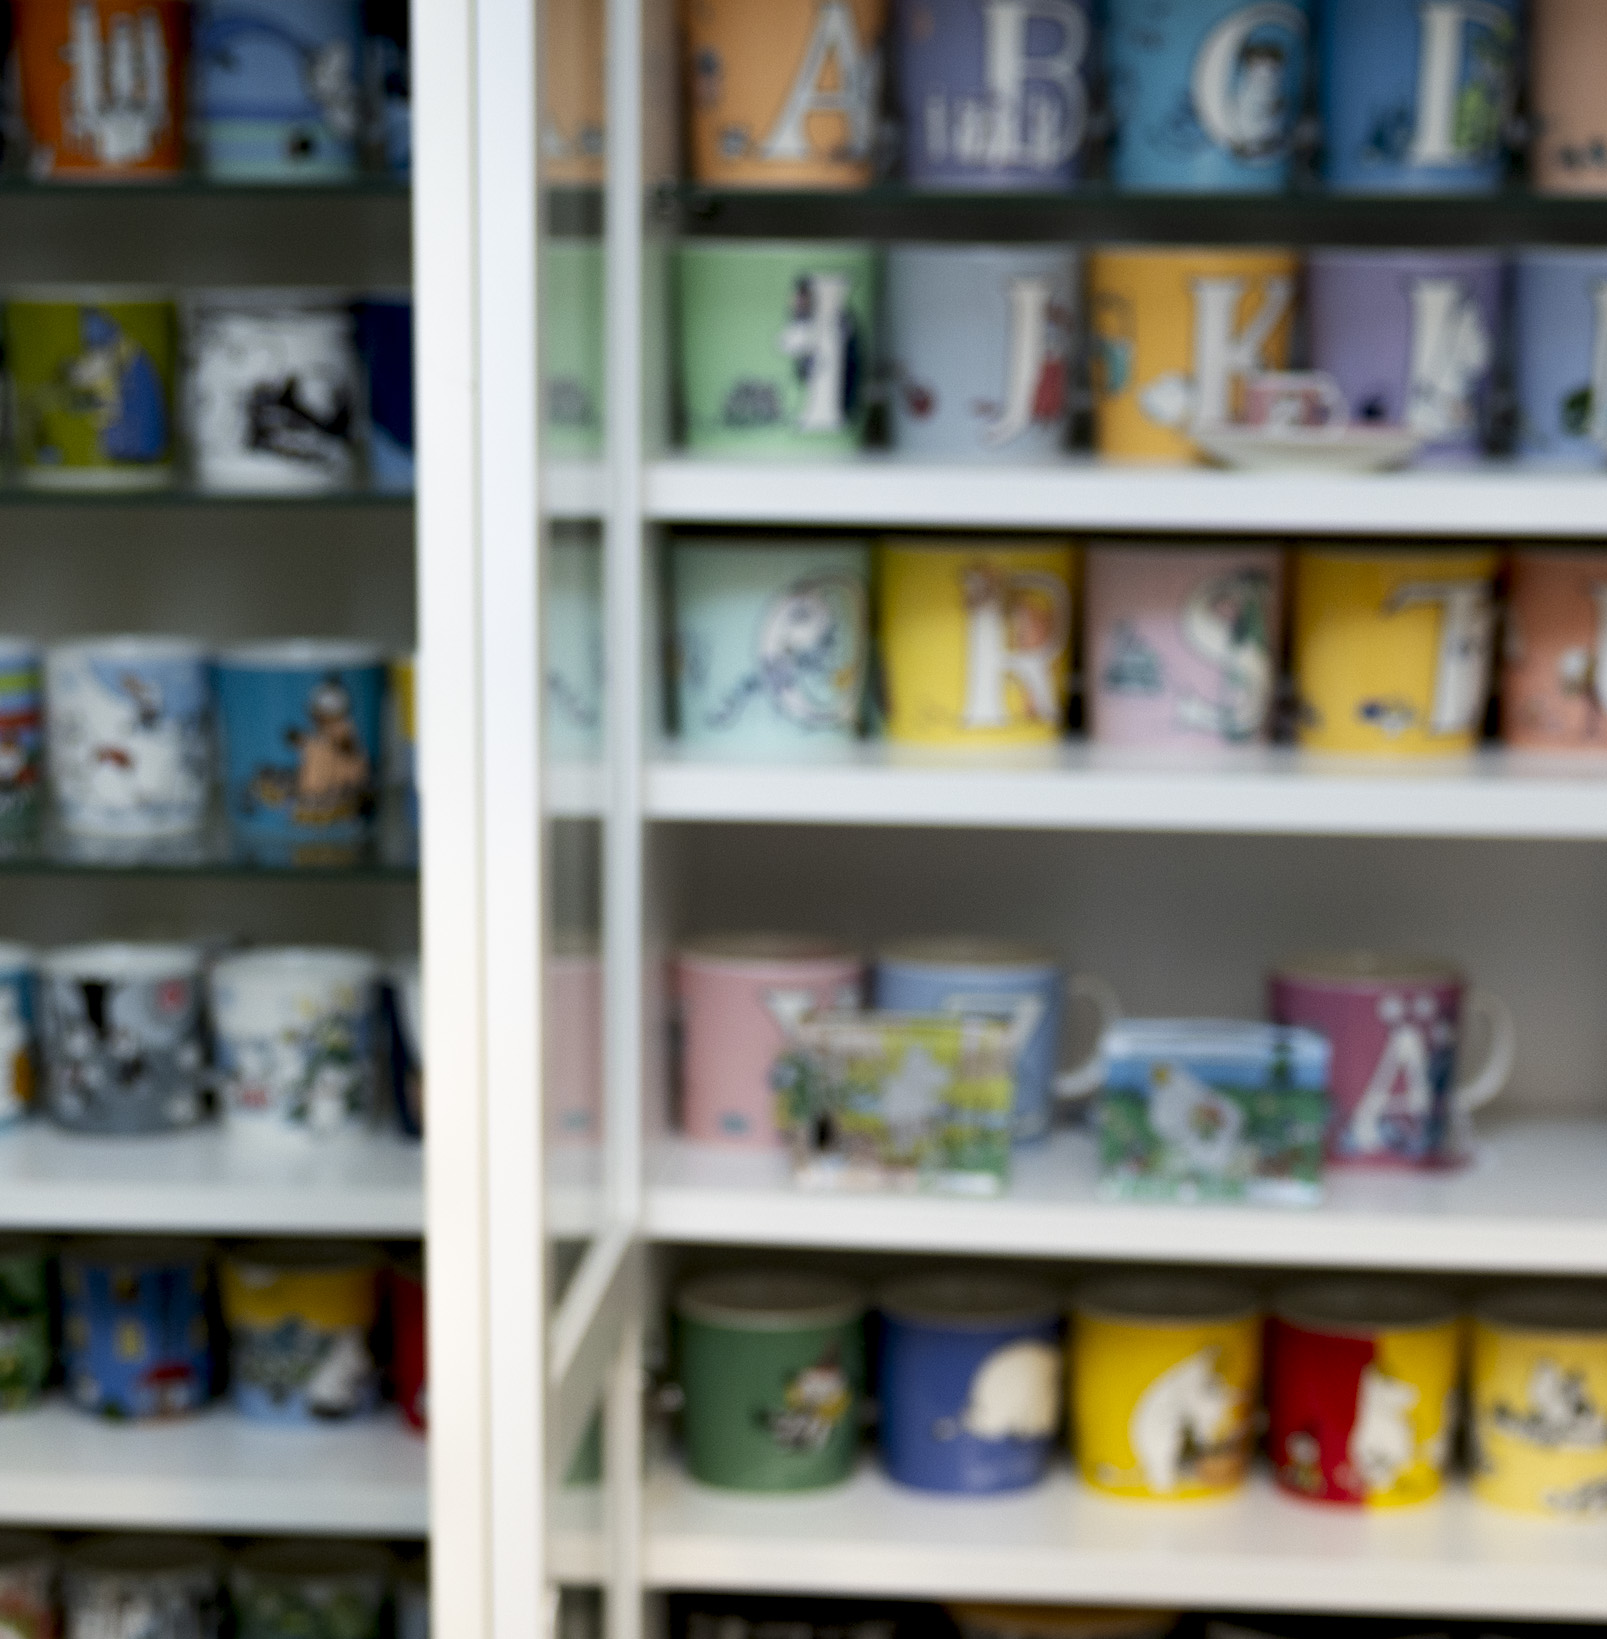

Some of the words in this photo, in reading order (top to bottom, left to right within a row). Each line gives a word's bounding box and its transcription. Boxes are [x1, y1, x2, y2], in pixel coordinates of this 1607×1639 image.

[756, 0, 881, 158] A
[983, 0, 1092, 167] B
[1191, 275, 1292, 430] K
[963, 568, 1069, 728] R
